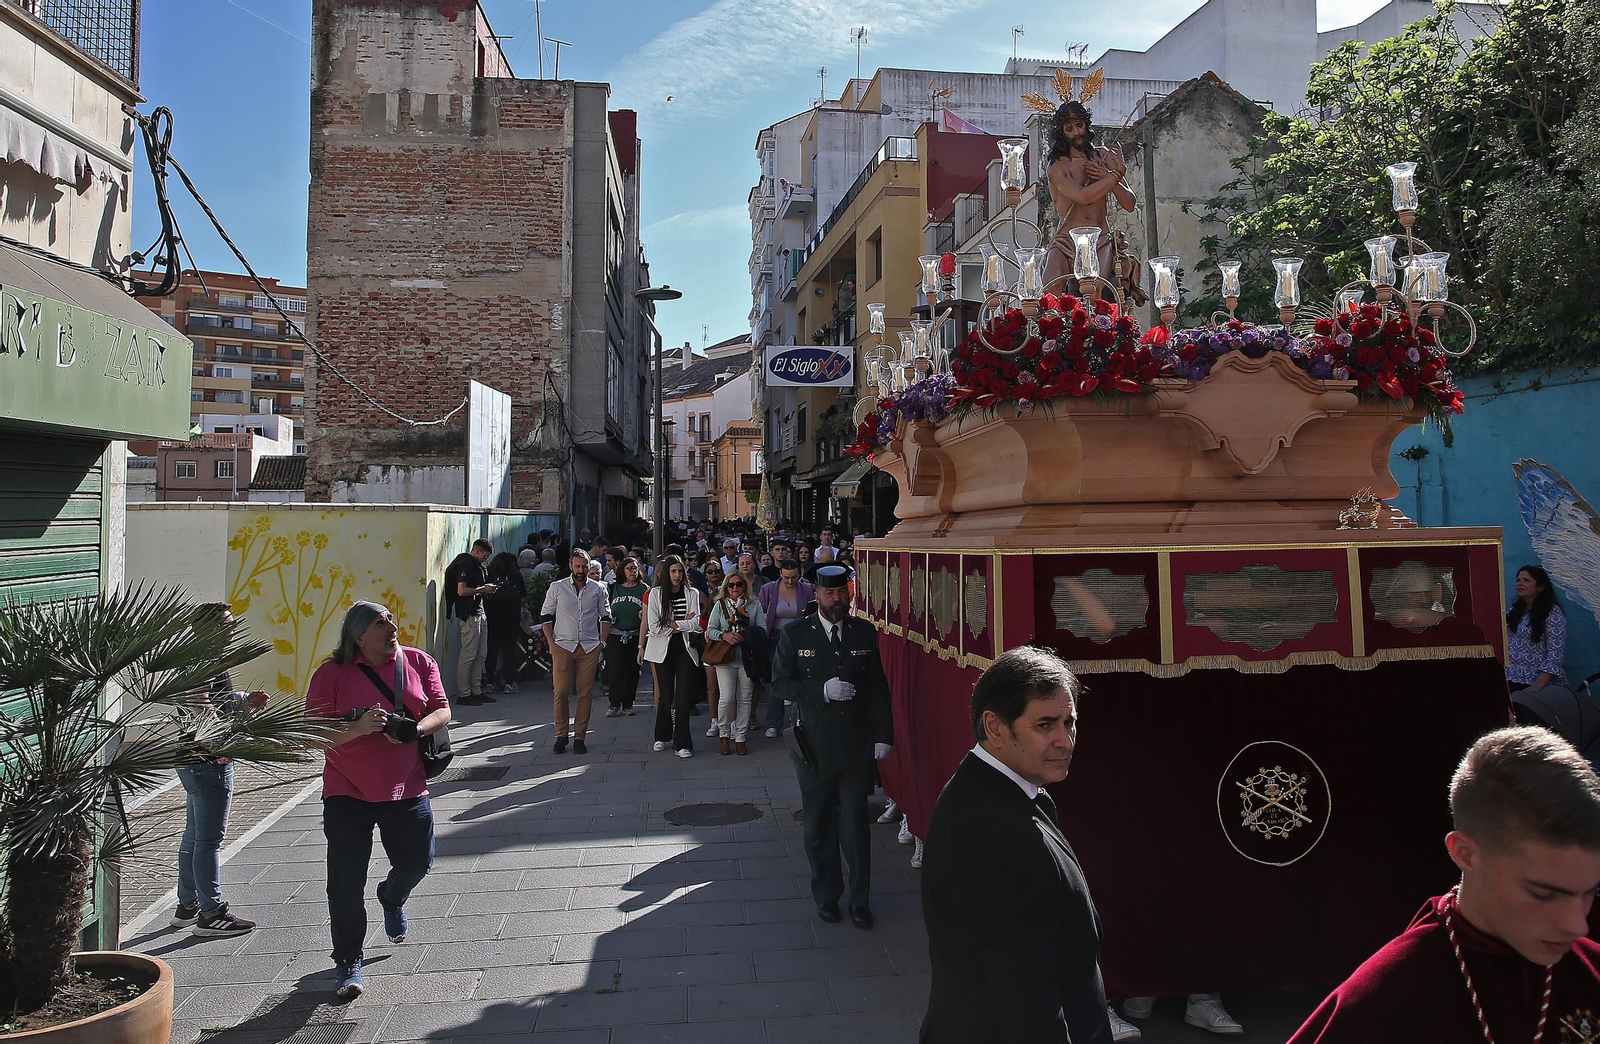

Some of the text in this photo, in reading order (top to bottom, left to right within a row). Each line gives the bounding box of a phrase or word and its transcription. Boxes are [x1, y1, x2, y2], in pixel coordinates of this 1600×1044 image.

[56, 320, 167, 391] BZAR
[773, 357, 786, 372] El
[788, 358, 819, 376] Siglo
[611, 595, 643, 607] NEW YORK
